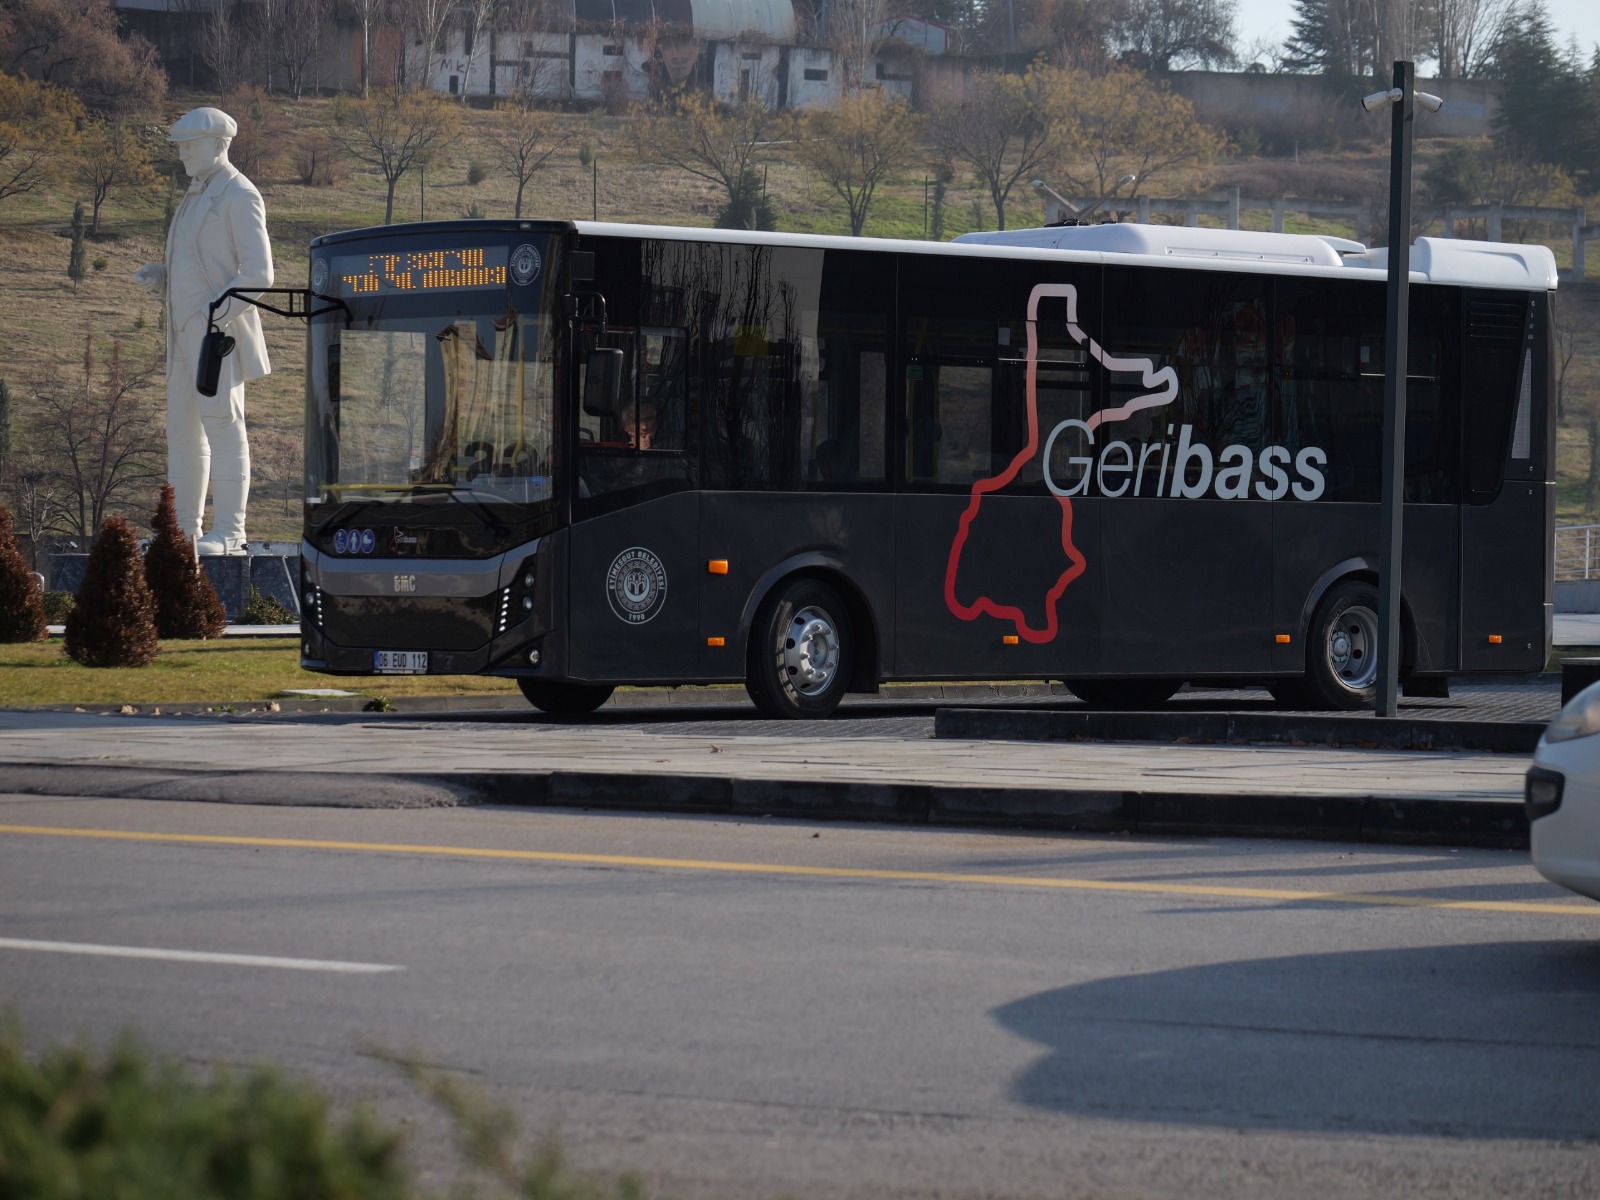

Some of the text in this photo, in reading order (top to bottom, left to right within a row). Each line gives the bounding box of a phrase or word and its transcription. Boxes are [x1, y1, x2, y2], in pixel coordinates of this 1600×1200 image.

[1042, 418, 1328, 501] Geribass
[393, 574, 416, 592] BMC
[629, 613, 645, 621] 1990
[379, 652, 427, 669] 06 EUD 112
